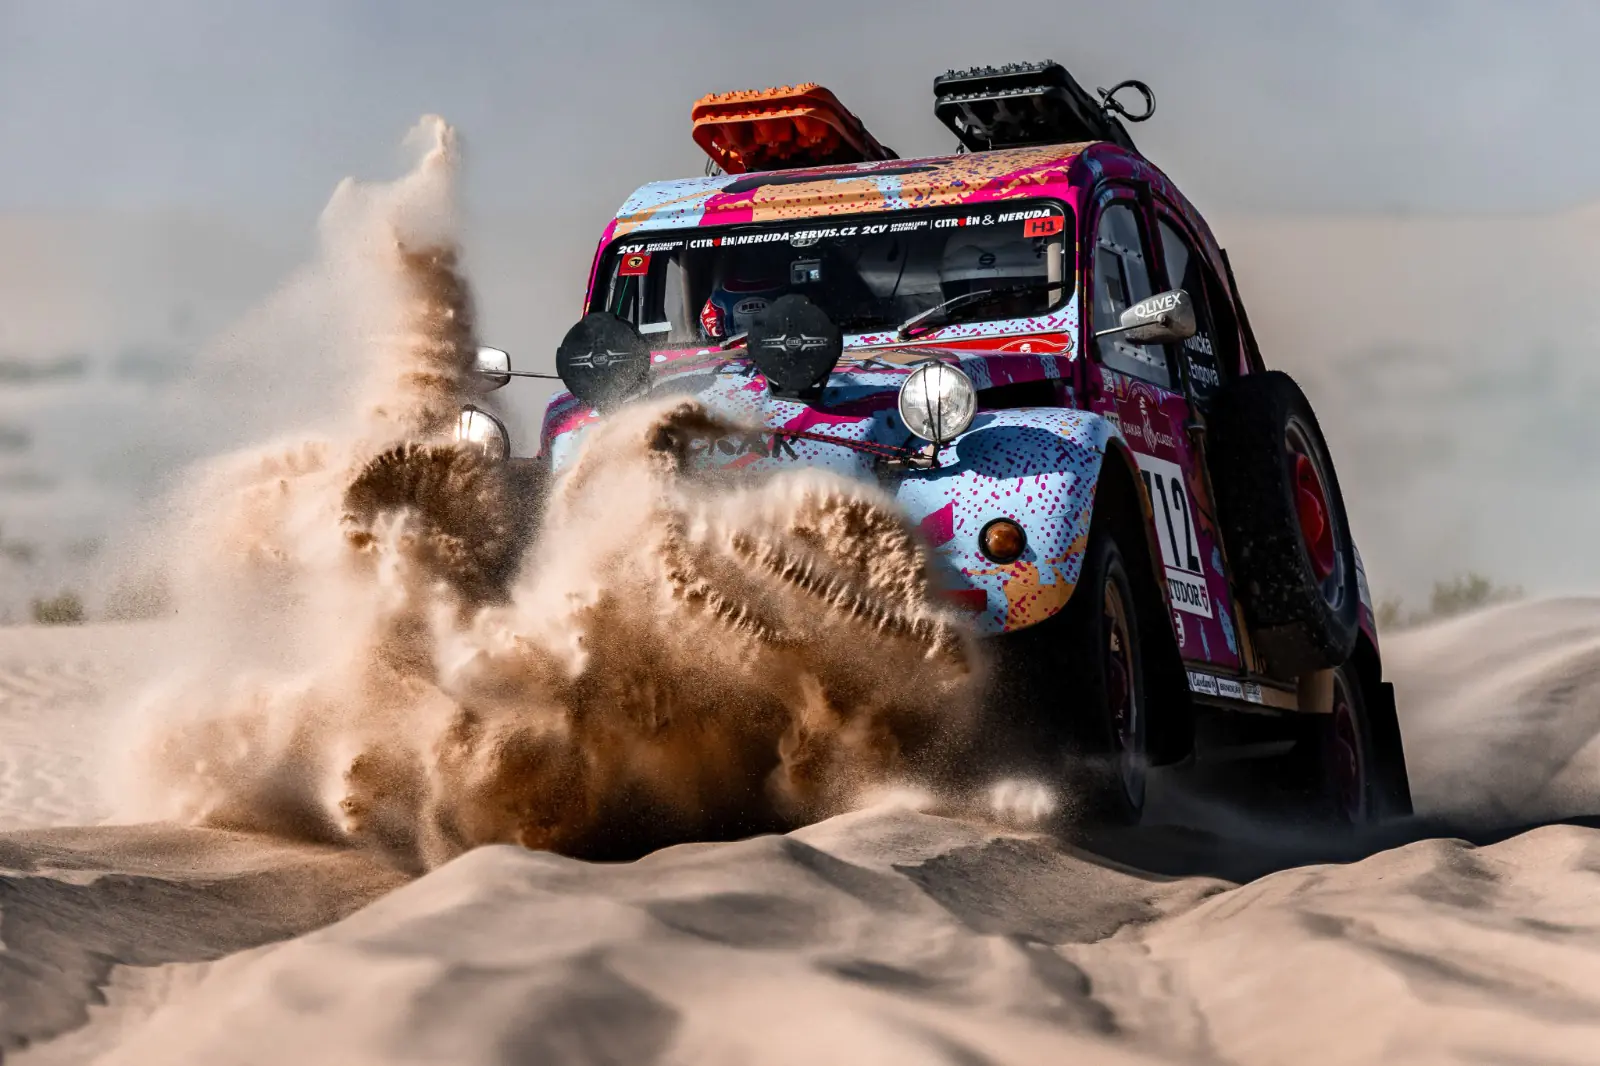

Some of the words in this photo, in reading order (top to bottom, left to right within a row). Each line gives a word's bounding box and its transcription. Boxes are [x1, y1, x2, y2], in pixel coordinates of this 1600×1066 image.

[617, 244, 645, 254] 2CV
[737, 227, 858, 245] NERUDA-SERVIS.CZ
[861, 224, 888, 235] 2CV
[982, 214, 995, 226] &
[998, 209, 1051, 222] NERUDA
[1032, 220, 1055, 233] H1
[1135, 293, 1181, 317] OLIVEX
